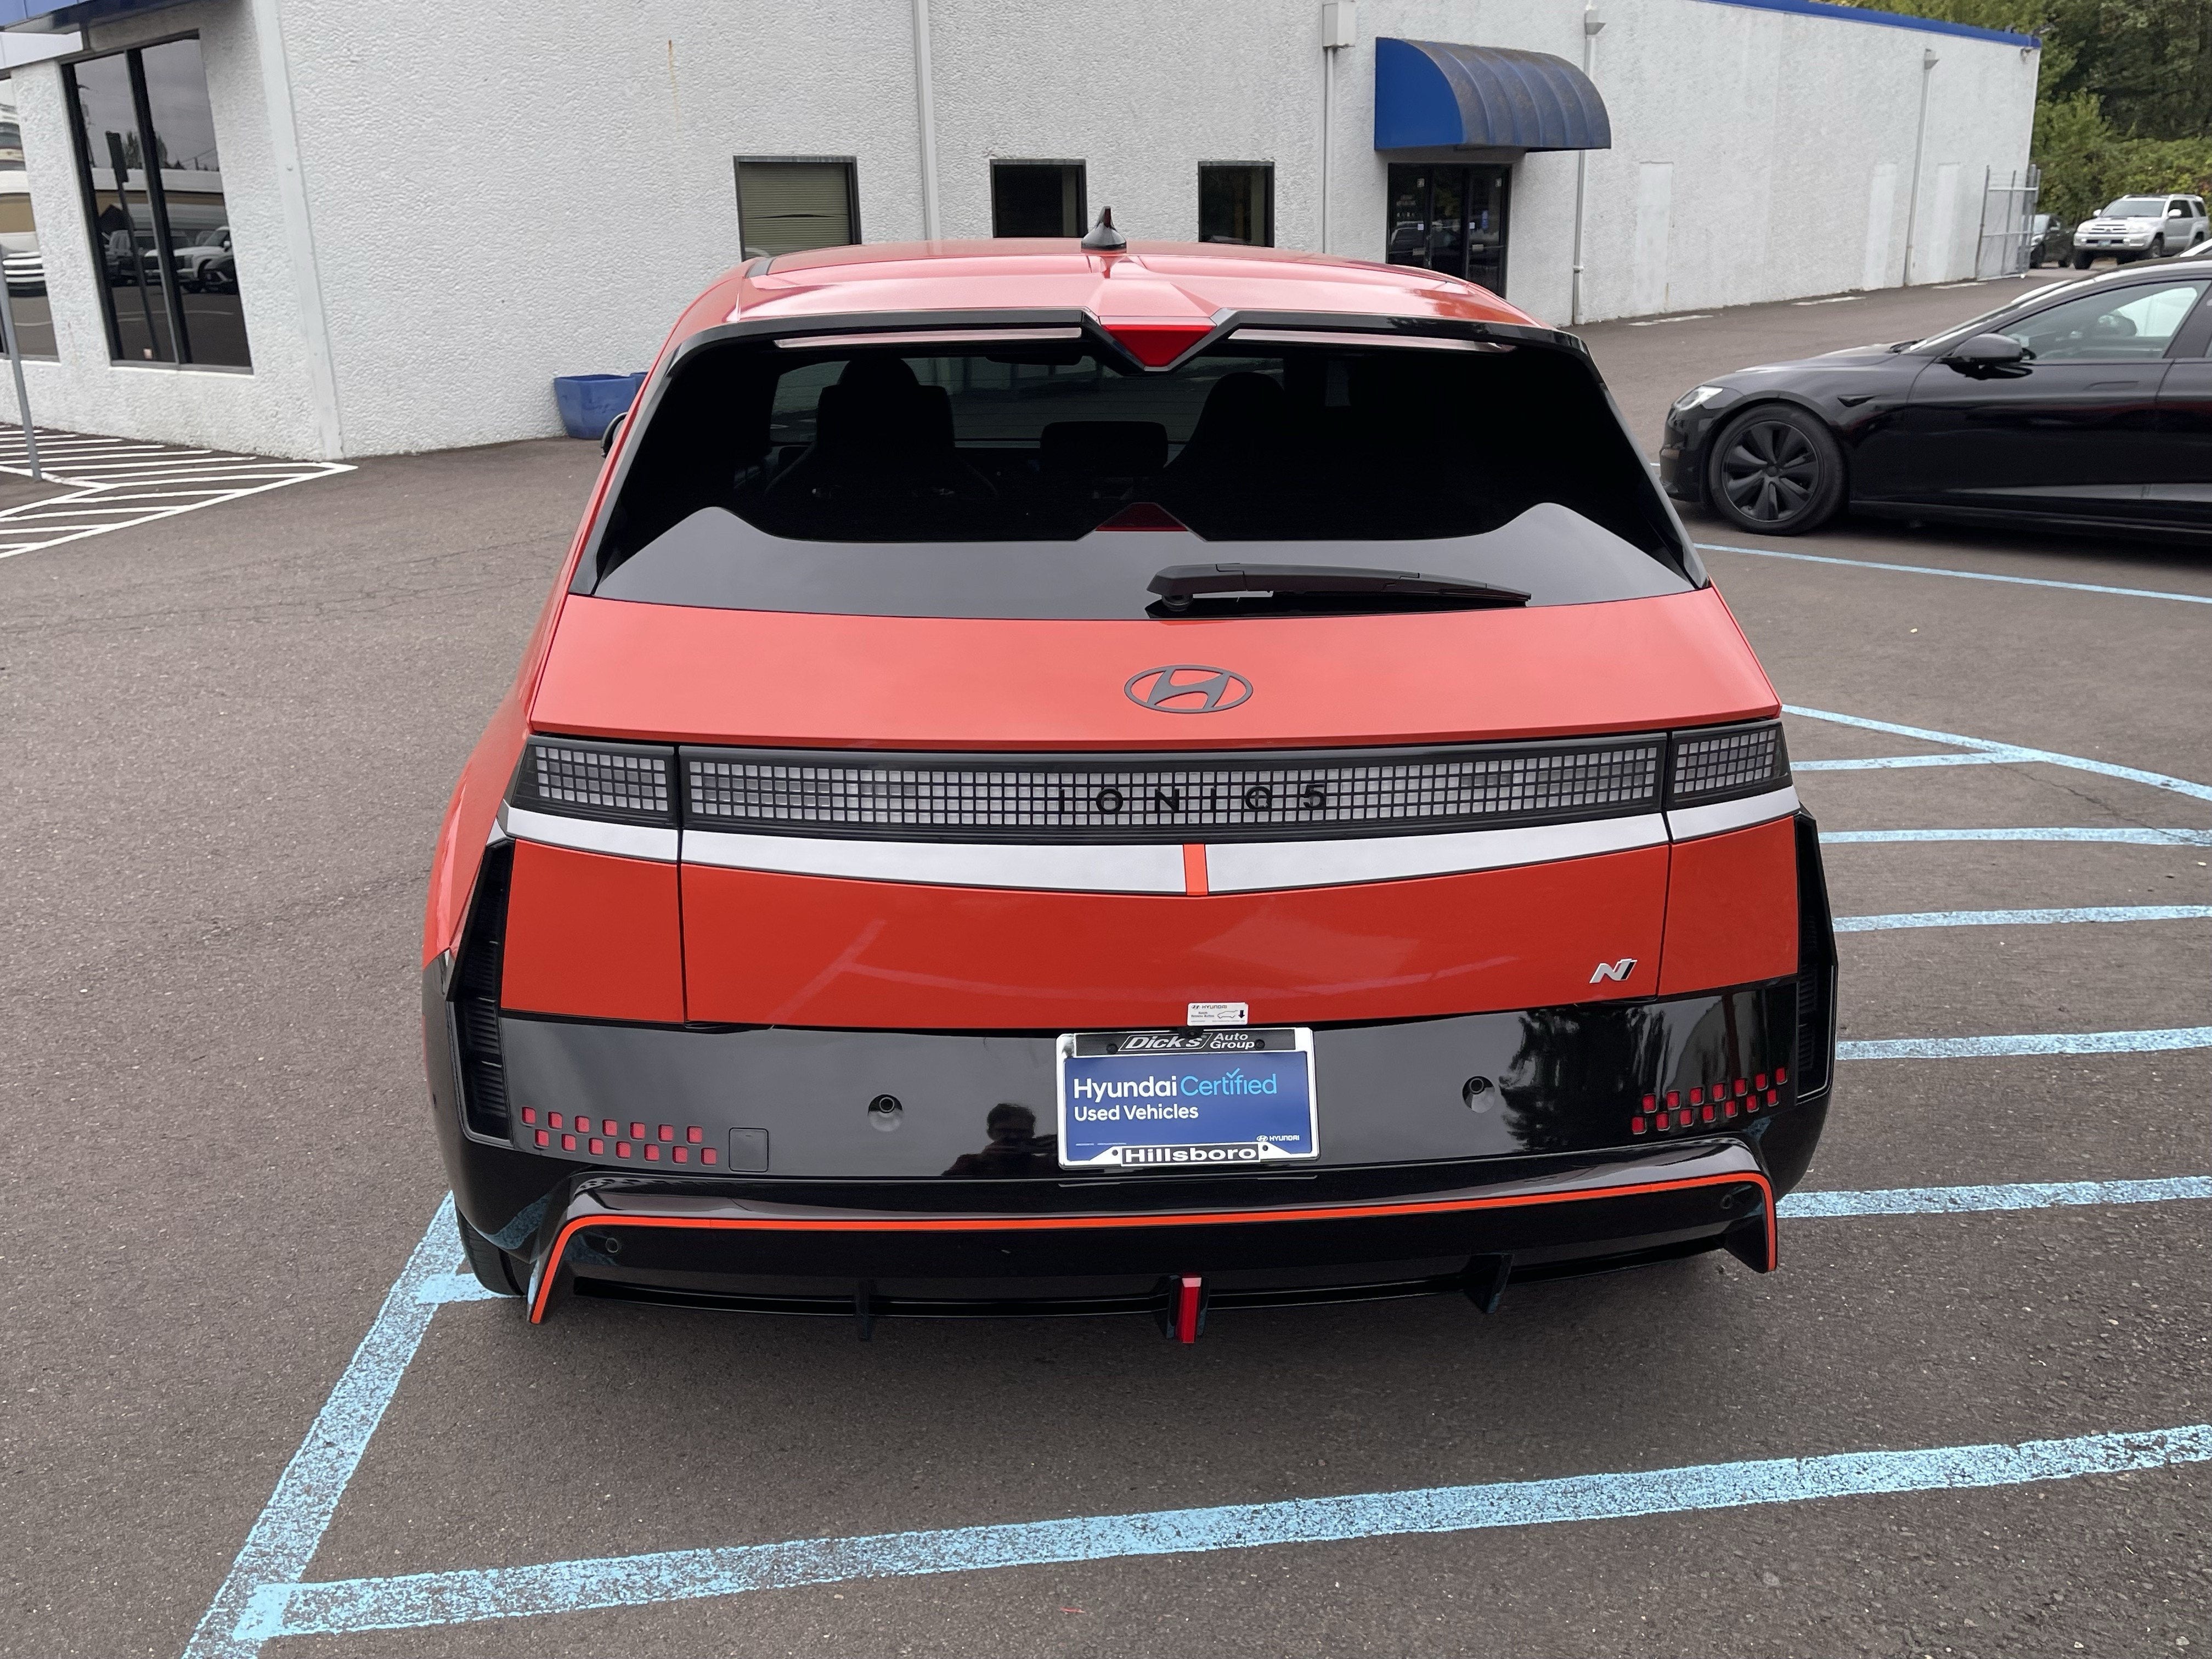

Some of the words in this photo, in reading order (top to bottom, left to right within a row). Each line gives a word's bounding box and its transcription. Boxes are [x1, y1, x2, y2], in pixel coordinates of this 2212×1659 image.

[1304, 783, 1325, 810] 5
[1125, 1036, 1203, 1049] Dicks
[1210, 1040, 1255, 1049] Group
[1214, 1032, 1248, 1041] Auto
[1074, 1075, 1177, 1103] Hyundai
[1181, 1068, 1277, 1096] Certified
[1074, 1105, 1120, 1121] Used
[1124, 1103, 1199, 1120] Vehicles
[1125, 1147, 1257, 1163] Hillsboro
